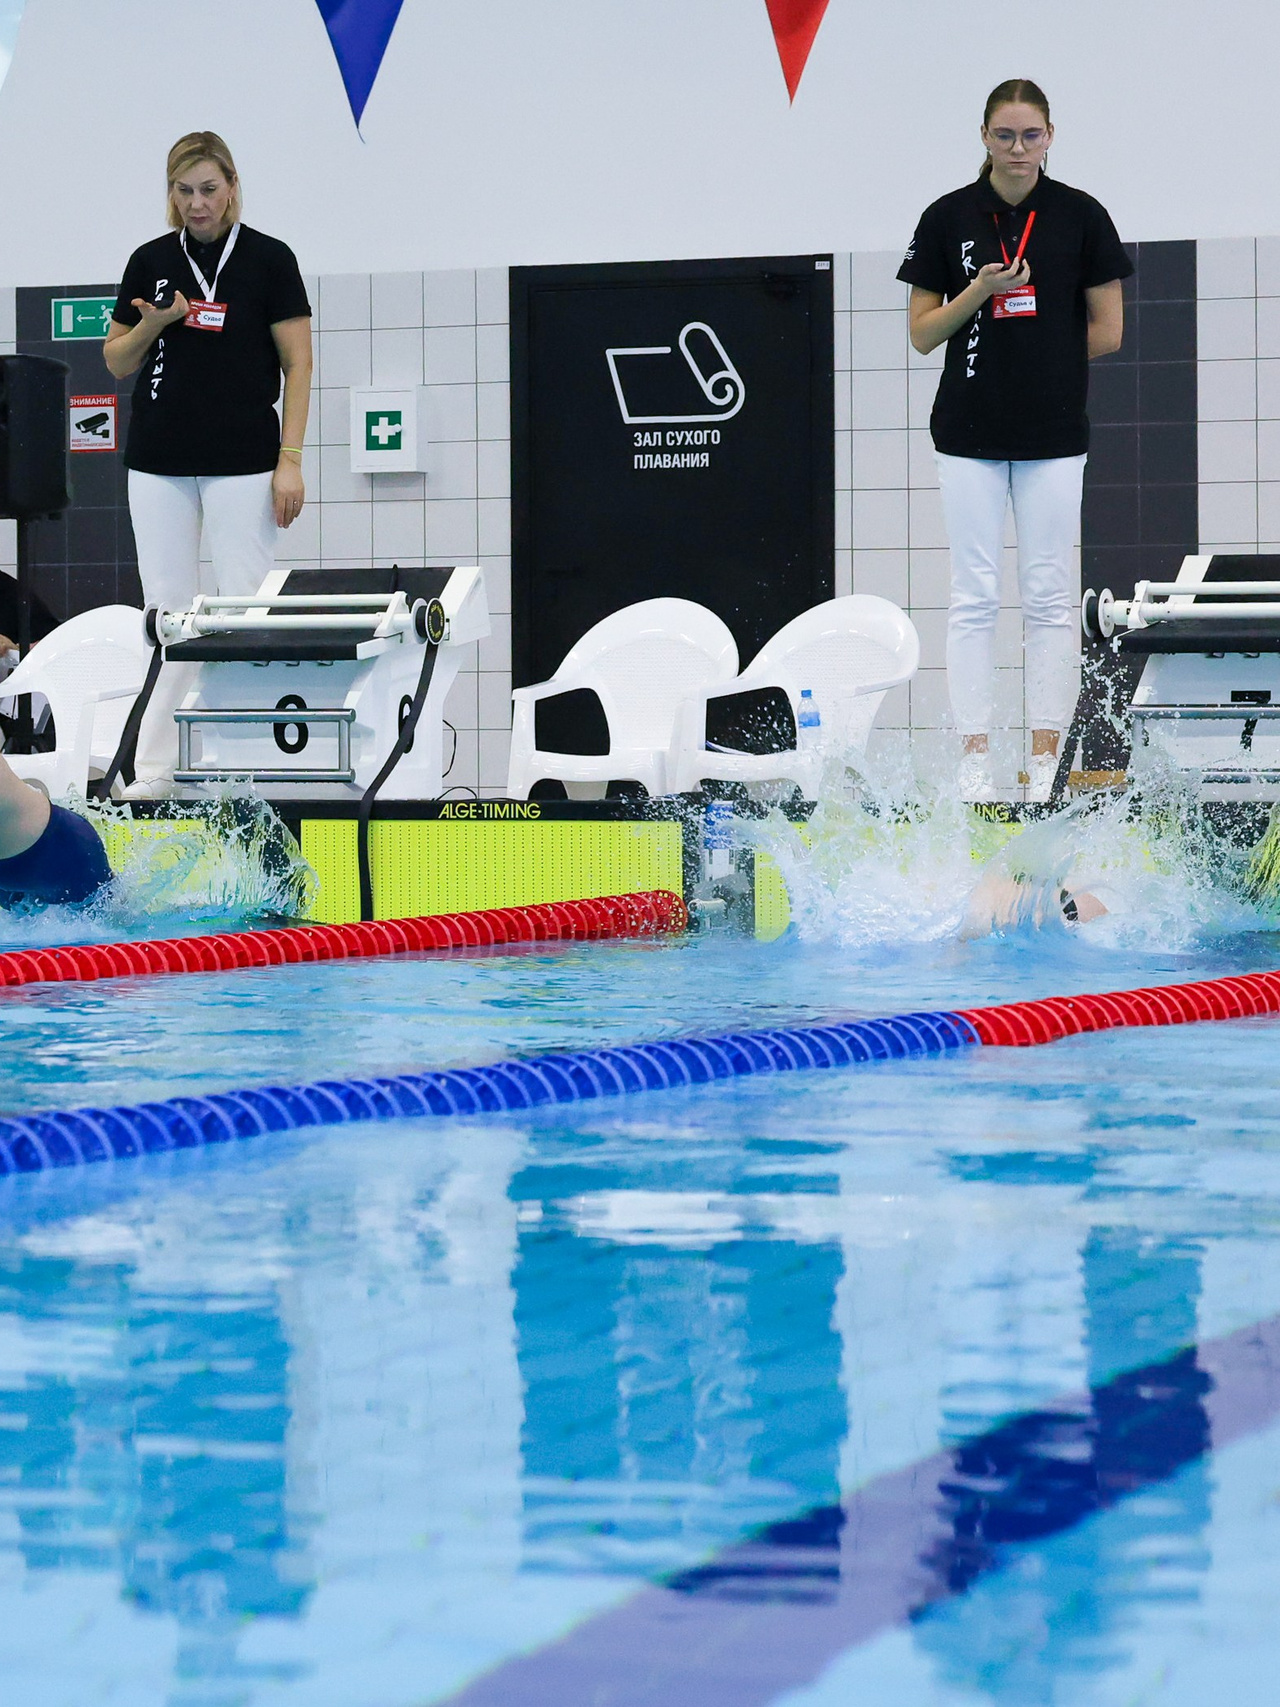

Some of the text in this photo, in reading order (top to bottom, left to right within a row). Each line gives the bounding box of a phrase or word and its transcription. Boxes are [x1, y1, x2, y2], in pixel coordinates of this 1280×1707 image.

[633, 429, 721, 447] ЗАЛ СУХОГО
[634, 452, 710, 469] ПЛАВАНИЯ
[1231, 690, 1271, 752] 7
[438, 803, 541, 819] ALGE-TIMING
